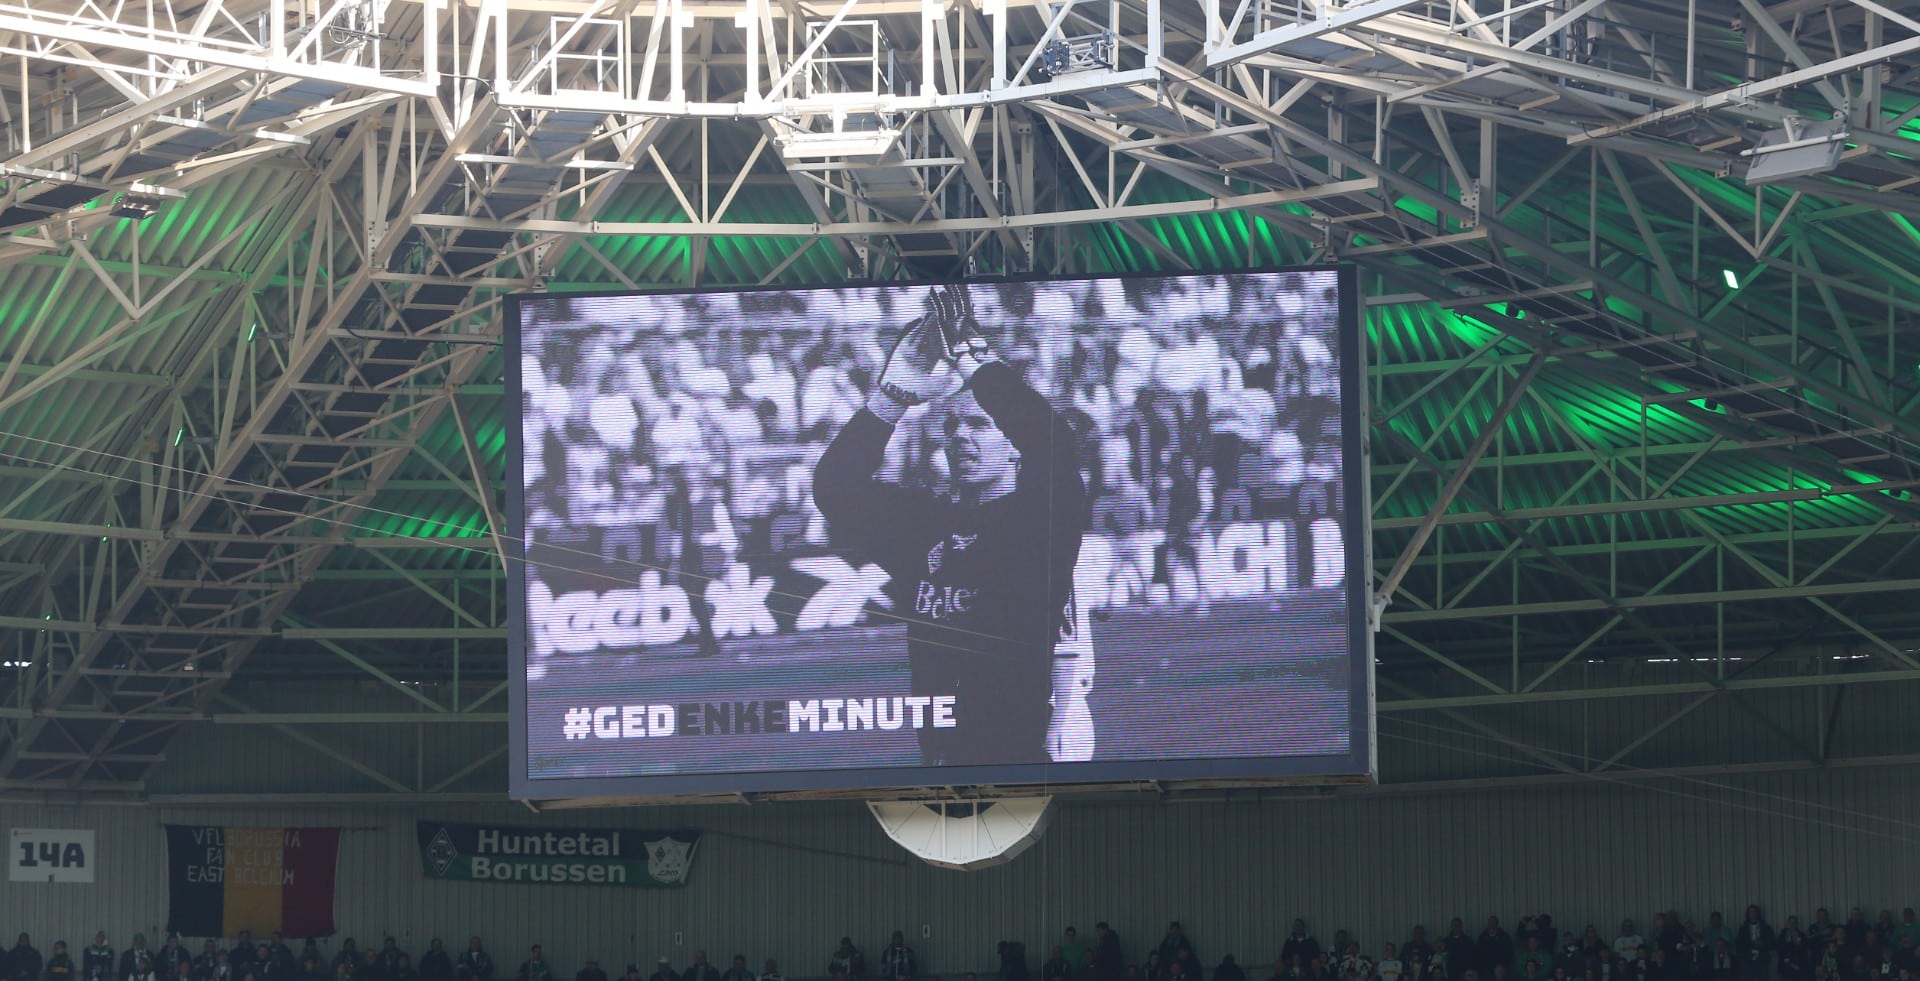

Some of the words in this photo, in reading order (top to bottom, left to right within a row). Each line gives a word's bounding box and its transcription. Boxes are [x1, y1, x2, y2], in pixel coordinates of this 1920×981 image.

[562, 696, 957, 740] #GEDENKEMINUTE
[19, 842, 85, 868] 14A
[478, 829, 620, 855] Huntetal
[206, 847, 235, 865] FAN
[471, 856, 626, 882] Borussen
[187, 865, 224, 883] EAST
